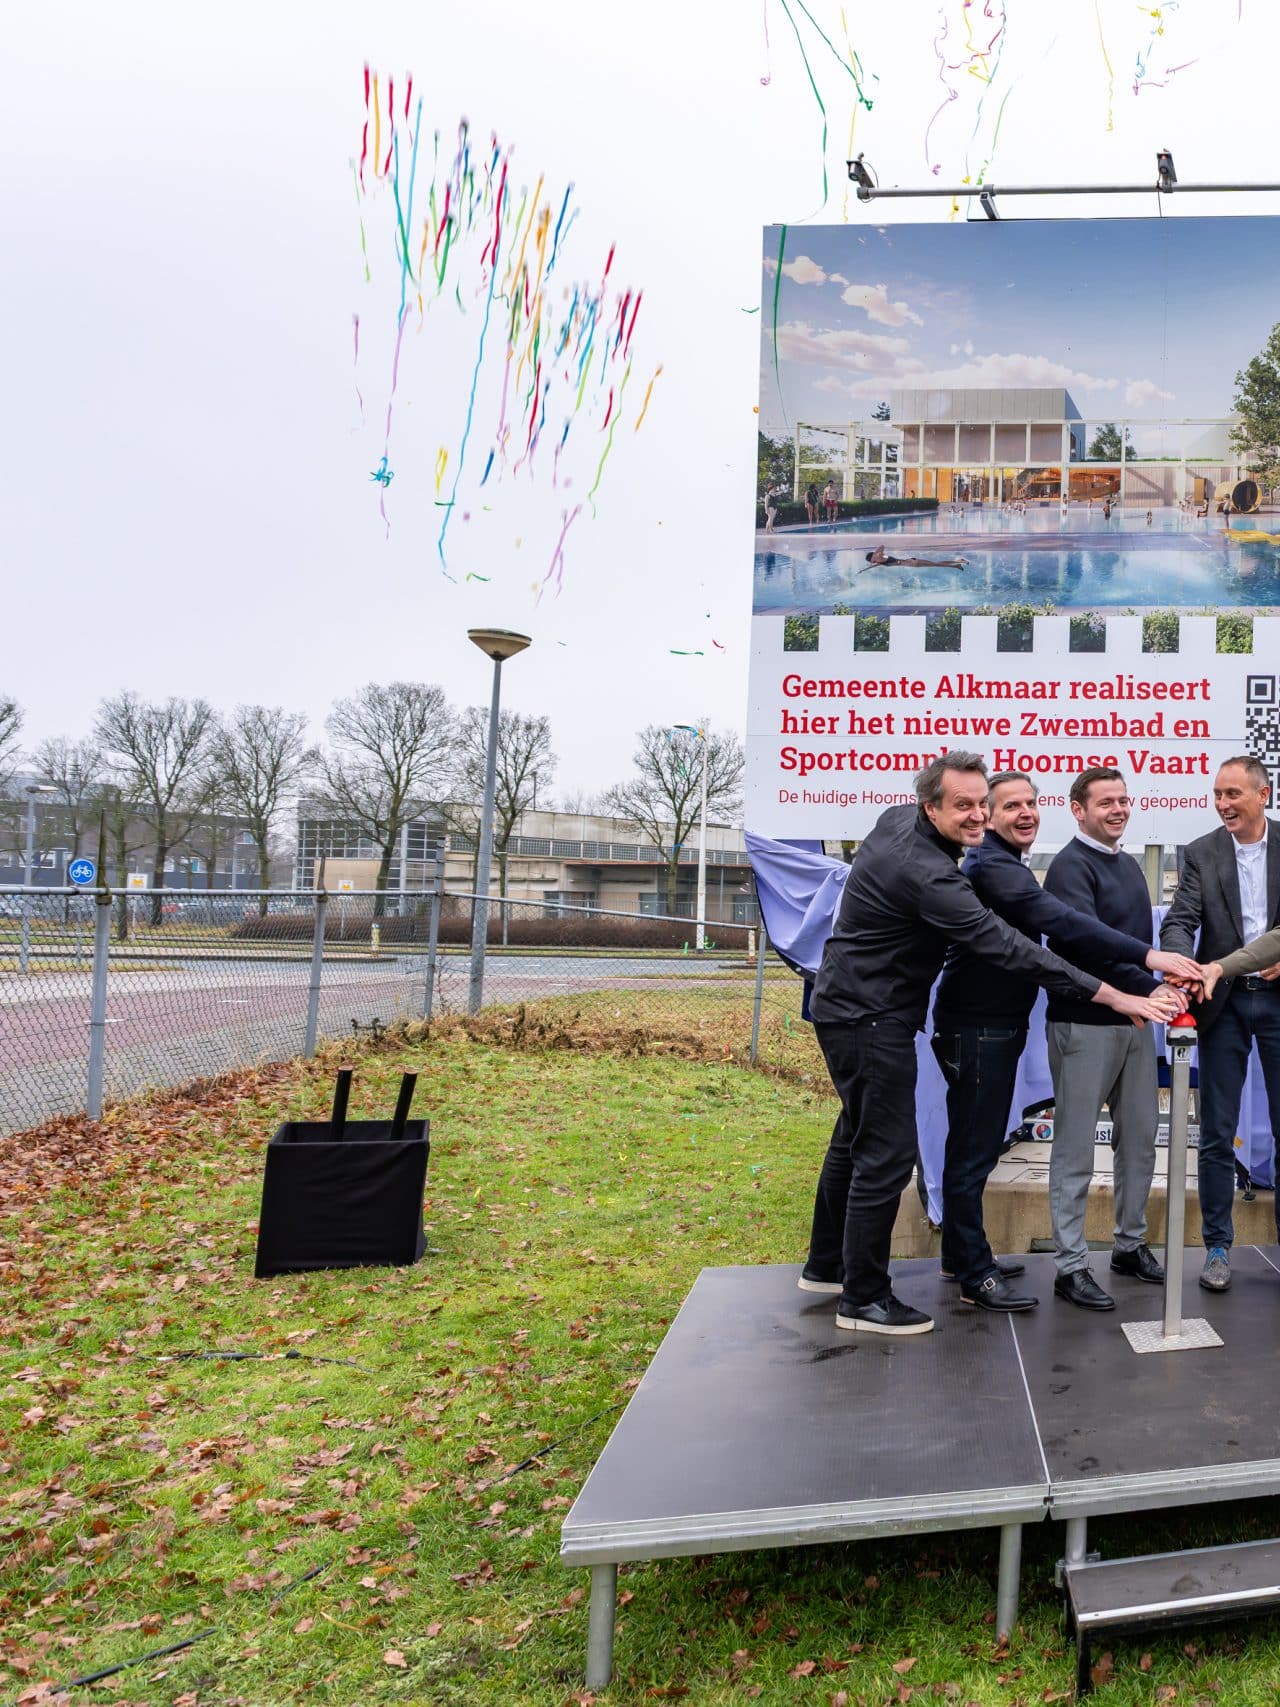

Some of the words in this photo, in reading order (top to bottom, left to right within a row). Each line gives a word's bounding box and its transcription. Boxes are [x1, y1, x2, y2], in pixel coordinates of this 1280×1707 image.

[782, 674, 926, 699] Gemeente
[933, 673, 1061, 700] Alkmaar
[1069, 674, 1211, 701] realiseert
[780, 709, 840, 735] hier
[847, 709, 895, 735] het
[903, 710, 1011, 736] nieuwe
[1019, 711, 1165, 738] Zwembad
[1173, 719, 1211, 739] en
[780, 746, 984, 776] Sportcom
[992, 748, 1119, 773] Hoornse
[1127, 749, 1210, 775] Vaart
[779, 789, 799, 804] De
[803, 788, 858, 808] huidige
[862, 790, 917, 805] Hoorns
[1140, 794, 1208, 811] geopend
